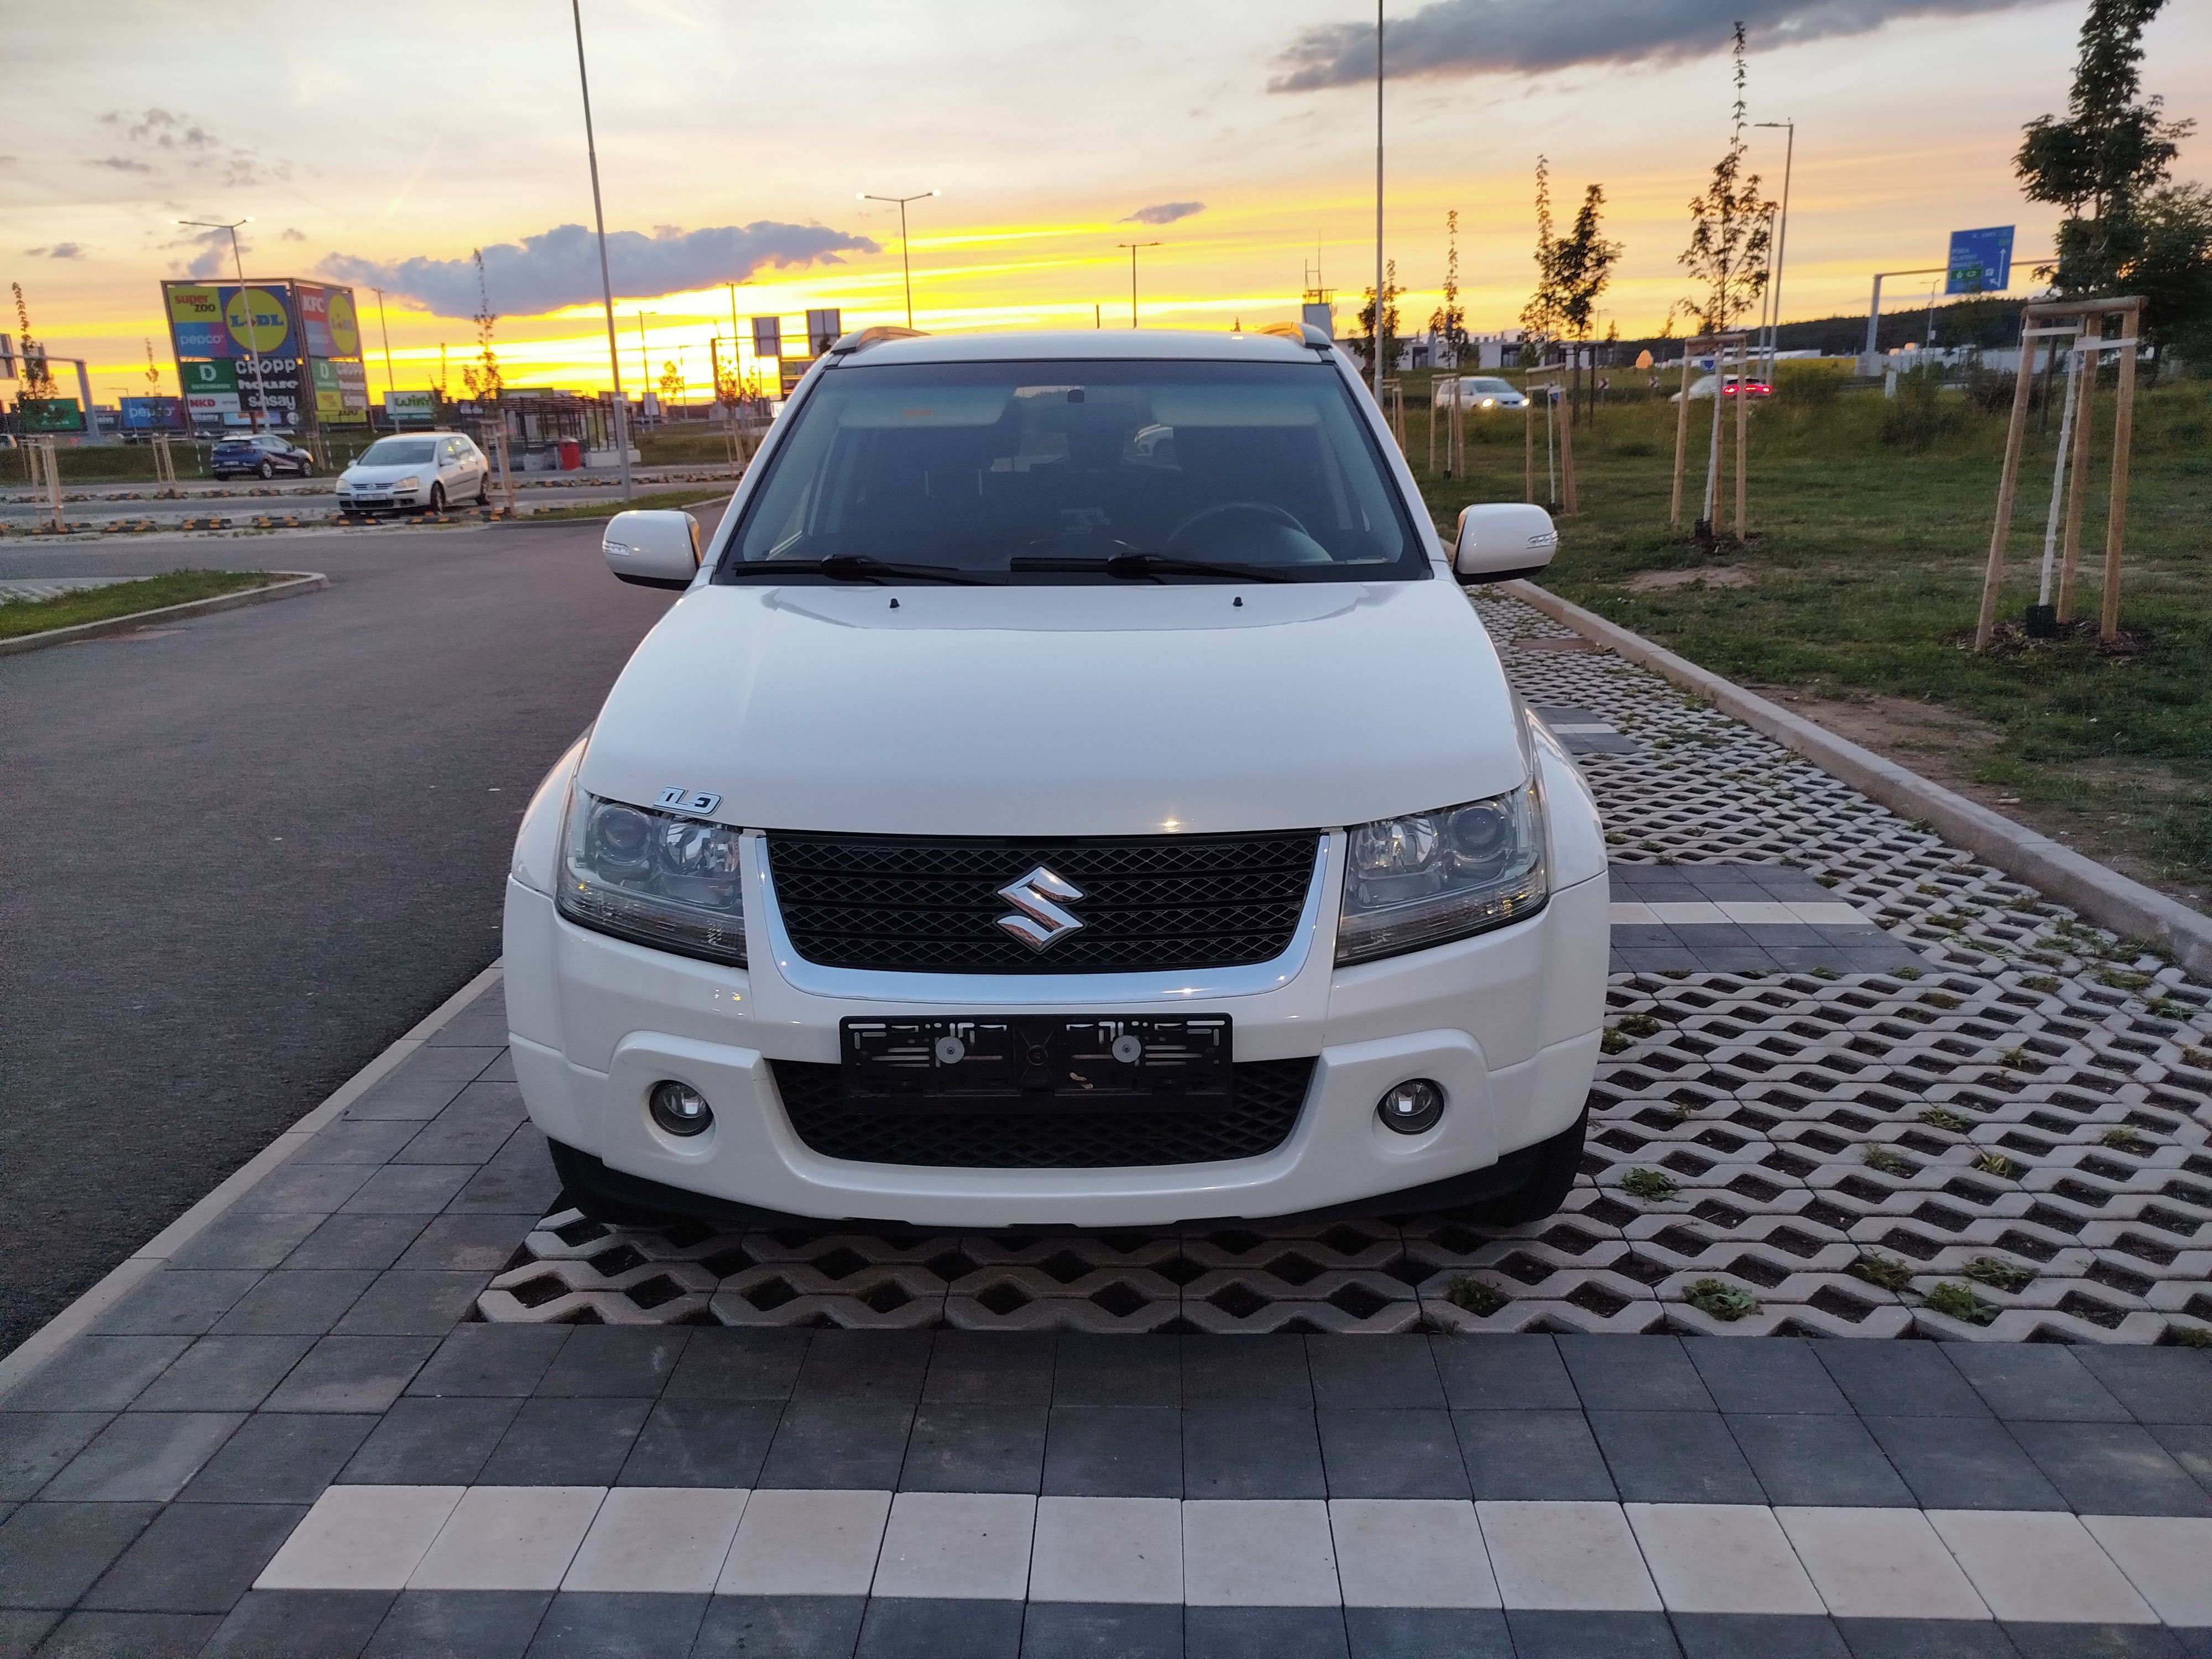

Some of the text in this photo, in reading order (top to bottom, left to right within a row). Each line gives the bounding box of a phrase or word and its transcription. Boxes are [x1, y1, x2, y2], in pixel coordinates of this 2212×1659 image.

[303, 296, 325, 313] KFC
[180, 335, 222, 346] pepco
[236, 359, 295, 374] CROPP
